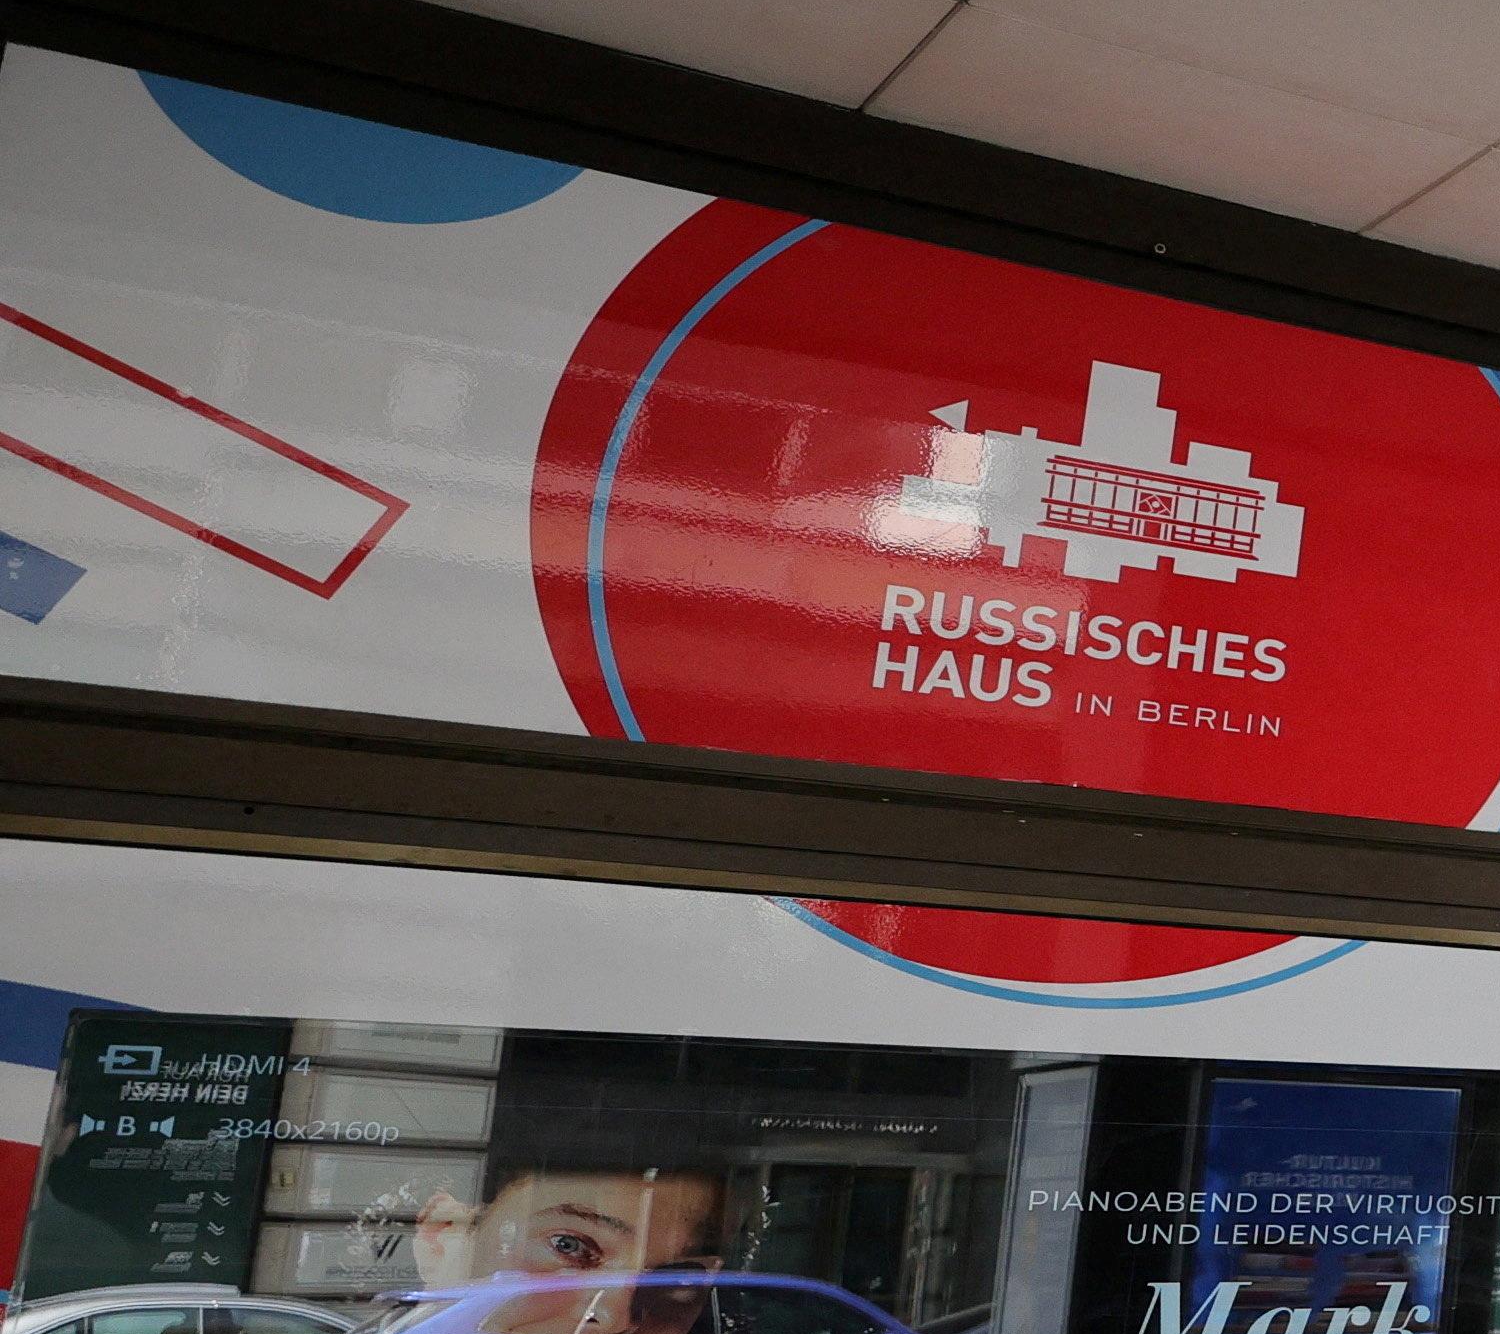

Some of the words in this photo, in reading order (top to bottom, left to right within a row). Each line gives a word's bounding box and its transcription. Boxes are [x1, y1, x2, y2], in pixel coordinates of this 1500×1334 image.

[880, 584, 1287, 682] RUSSISCHES
[872, 642, 1053, 708] HAUS
[1074, 692, 1113, 717] IN
[1137, 700, 1282, 737] BERLIN
[200, 1053, 285, 1075] HDMI
[293, 1056, 311, 1076] 4
[117, 1115, 136, 1136] B
[217, 1117, 400, 1146] 3840x2160p
[1028, 1189, 1259, 1215] PIANOABEND
[1270, 1192, 1334, 1214] DER
[1126, 1223, 1202, 1245] UND
[1213, 1223, 1450, 1246] LEIDENSCHAFT
